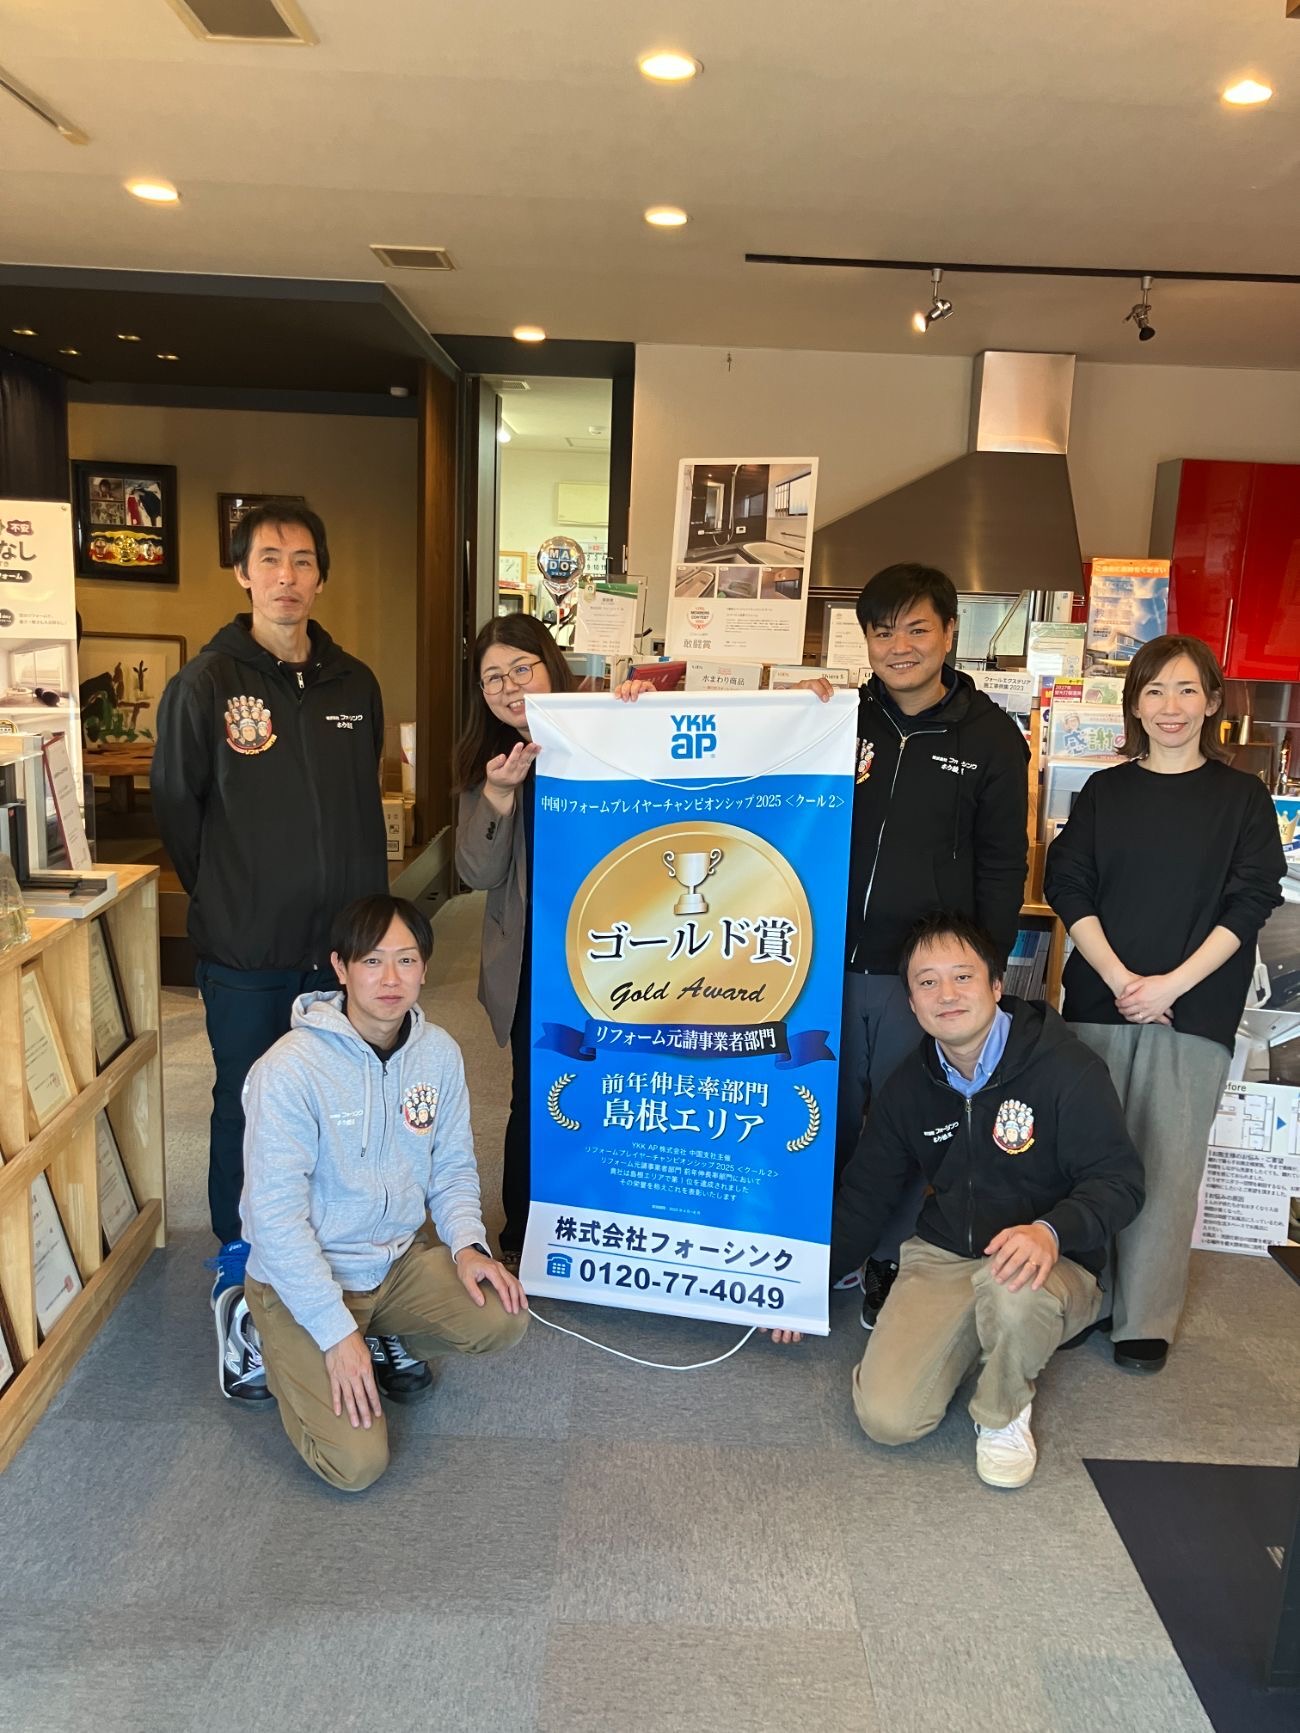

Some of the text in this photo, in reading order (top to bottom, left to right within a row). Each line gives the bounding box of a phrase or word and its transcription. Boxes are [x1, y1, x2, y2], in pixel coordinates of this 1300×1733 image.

[702, 674, 745, 686] 水まわり商品
[671, 714, 717, 732] YKK
[587, 917, 797, 966] ゴールド賞
[610, 976, 768, 1011] Gold Award
[596, 1025, 777, 1052] リフォーム元請事業者部門
[602, 1072, 769, 1108] 前年伸長率部門
[603, 1097, 765, 1143] 島根エリア
[554, 1215, 794, 1273] 株式会社フォーシンク
[579, 1258, 785, 1310] 0120-77-4049
